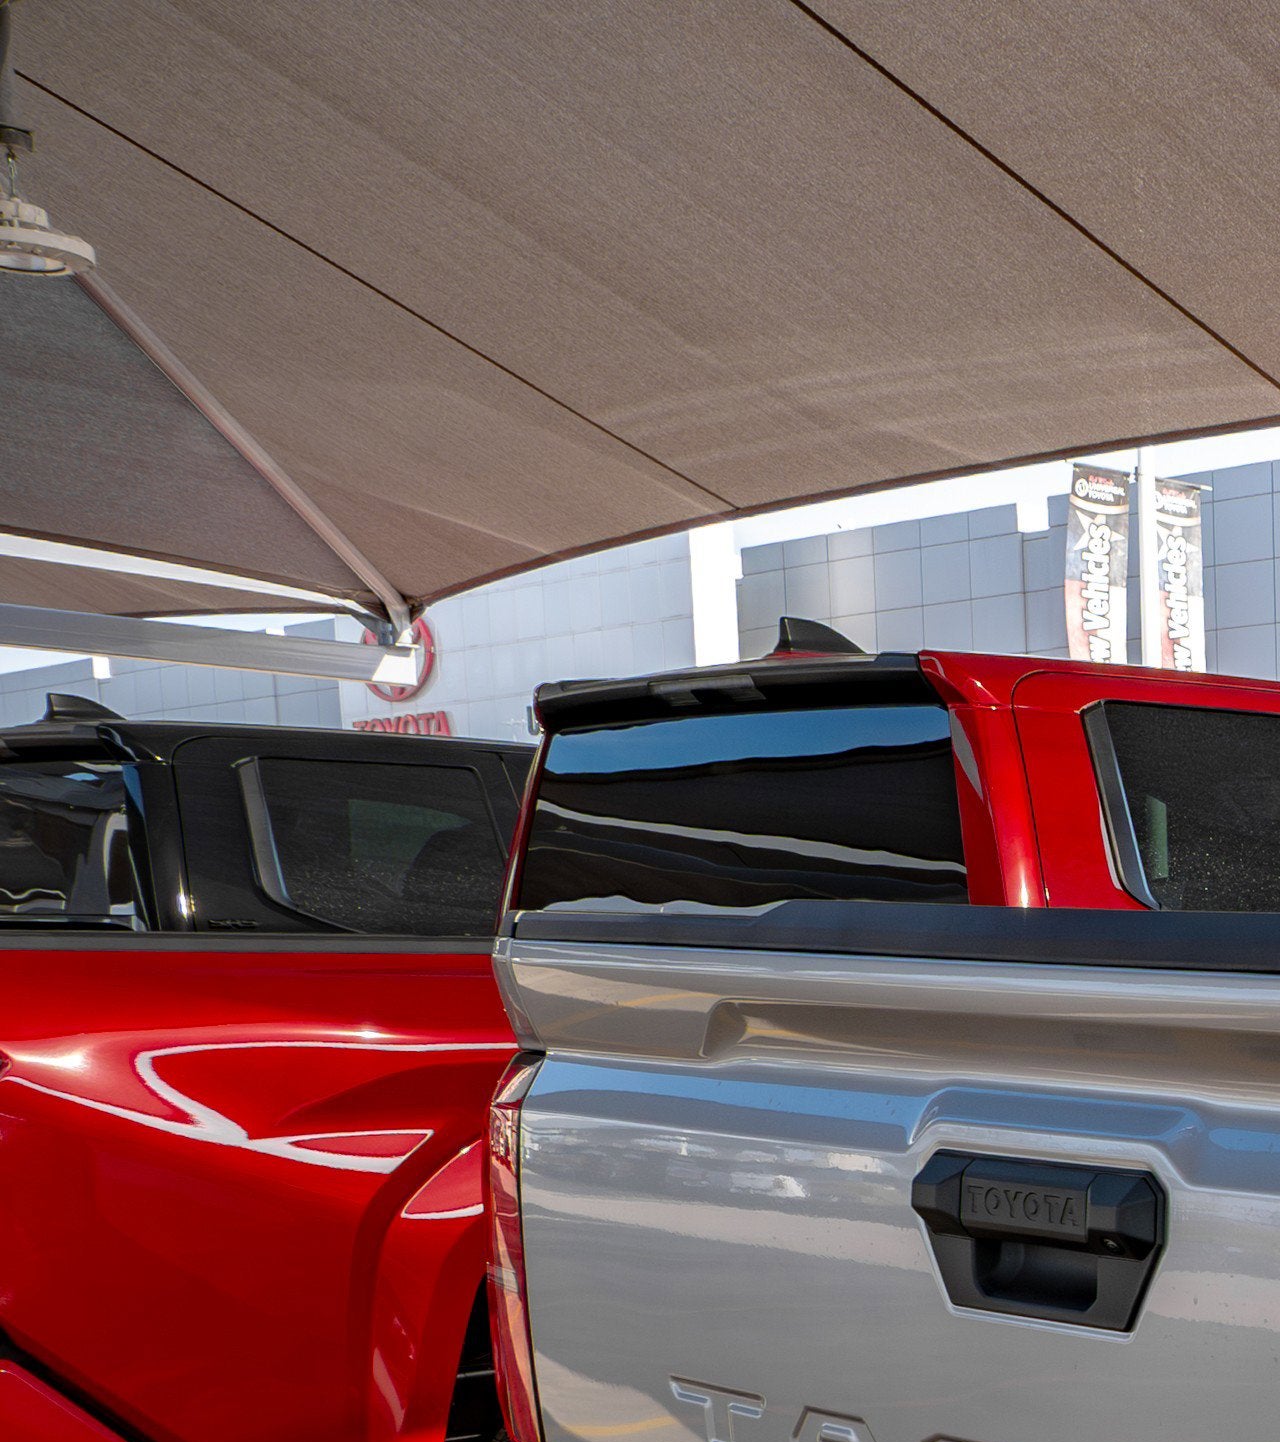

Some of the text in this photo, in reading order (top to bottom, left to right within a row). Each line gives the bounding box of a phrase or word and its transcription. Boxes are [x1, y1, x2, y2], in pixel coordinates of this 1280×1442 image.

[1081, 523, 1111, 631] Vehicles
[1162, 535, 1190, 640] Vehicles
[967, 1184, 1080, 1227] TOYOTA
